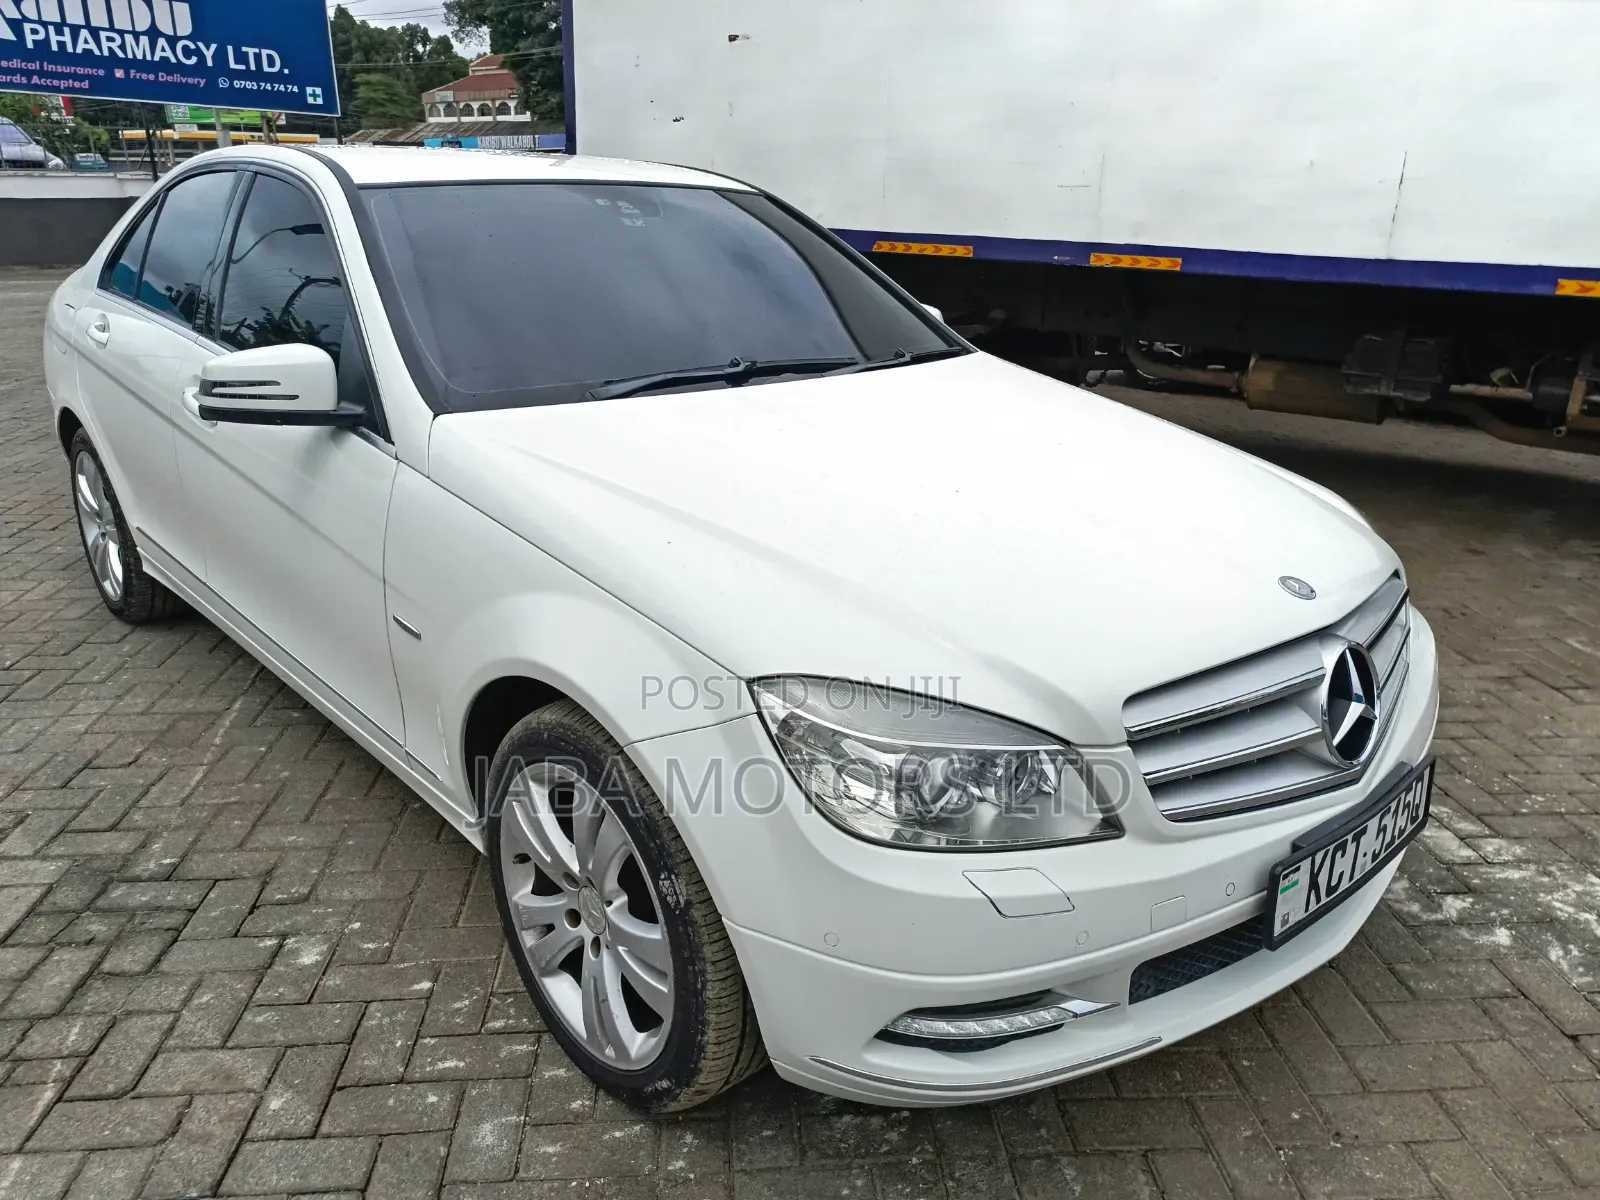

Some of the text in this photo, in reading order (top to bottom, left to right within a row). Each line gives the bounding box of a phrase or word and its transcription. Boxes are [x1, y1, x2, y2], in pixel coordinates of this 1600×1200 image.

[23, 22, 290, 75] PHARMACY LTD.
[0, 58, 105, 77] edical Insurance
[0, 73, 89, 90] ards Accepted
[129, 69, 207, 88] Free Delivery
[233, 80, 299, 93] 0703 74 74 74
